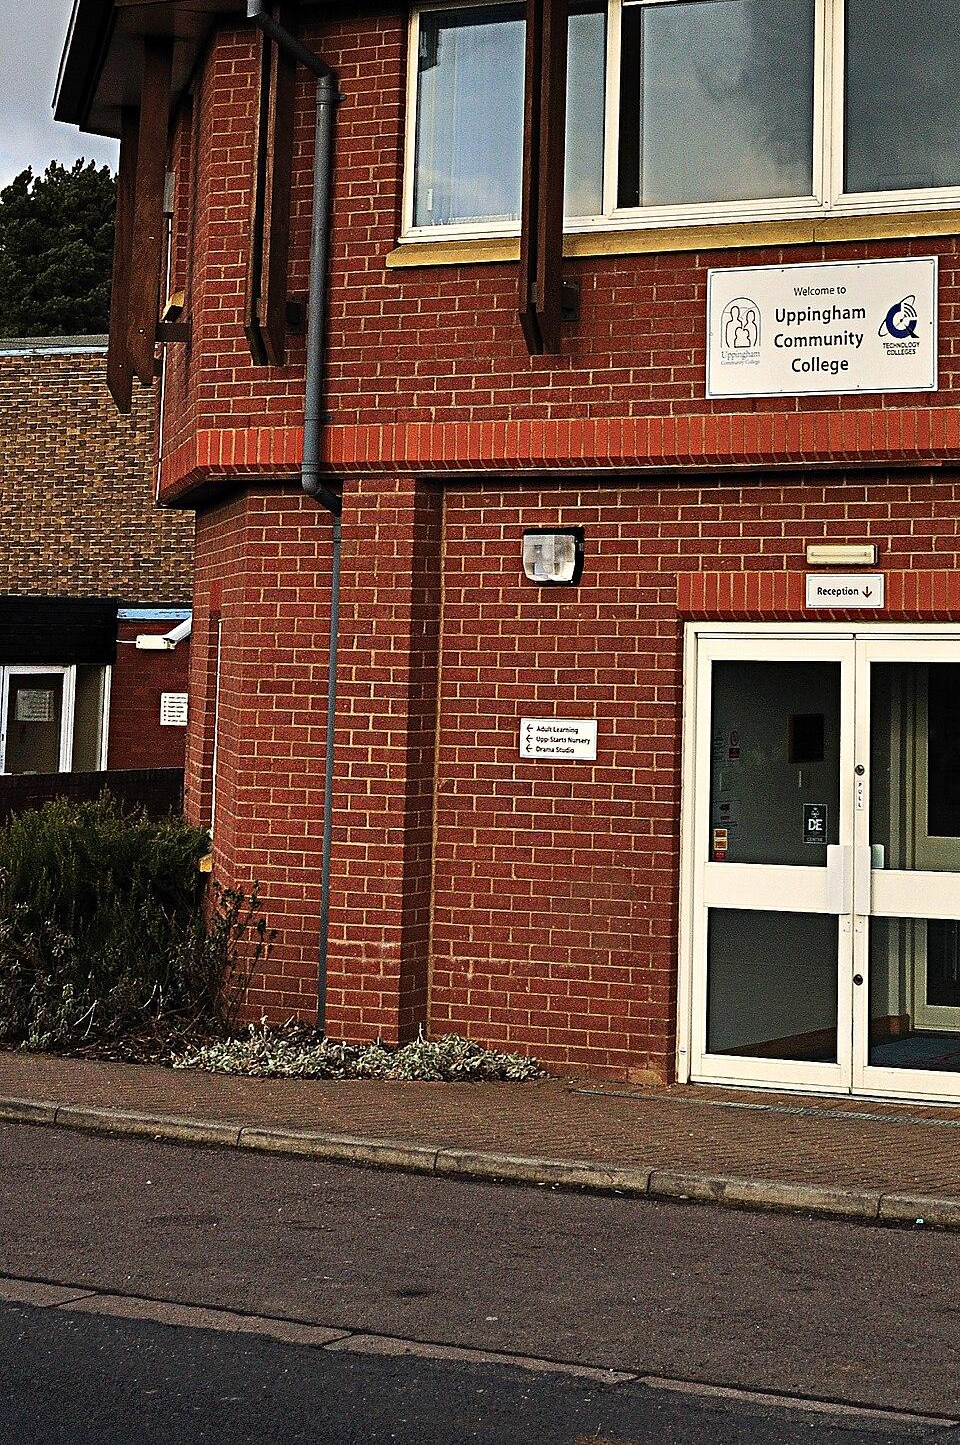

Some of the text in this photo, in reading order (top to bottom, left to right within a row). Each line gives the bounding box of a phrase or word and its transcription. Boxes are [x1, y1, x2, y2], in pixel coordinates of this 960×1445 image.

[793, 286, 847, 296] Welcome to
[775, 305, 866, 326] Uppingham
[774, 330, 864, 349] Community
[882, 341, 920, 350] TECHNOLOGY
[791, 356, 849, 375] College
[817, 586, 859, 597] Reception
[568, 737, 590, 745] Nursery
